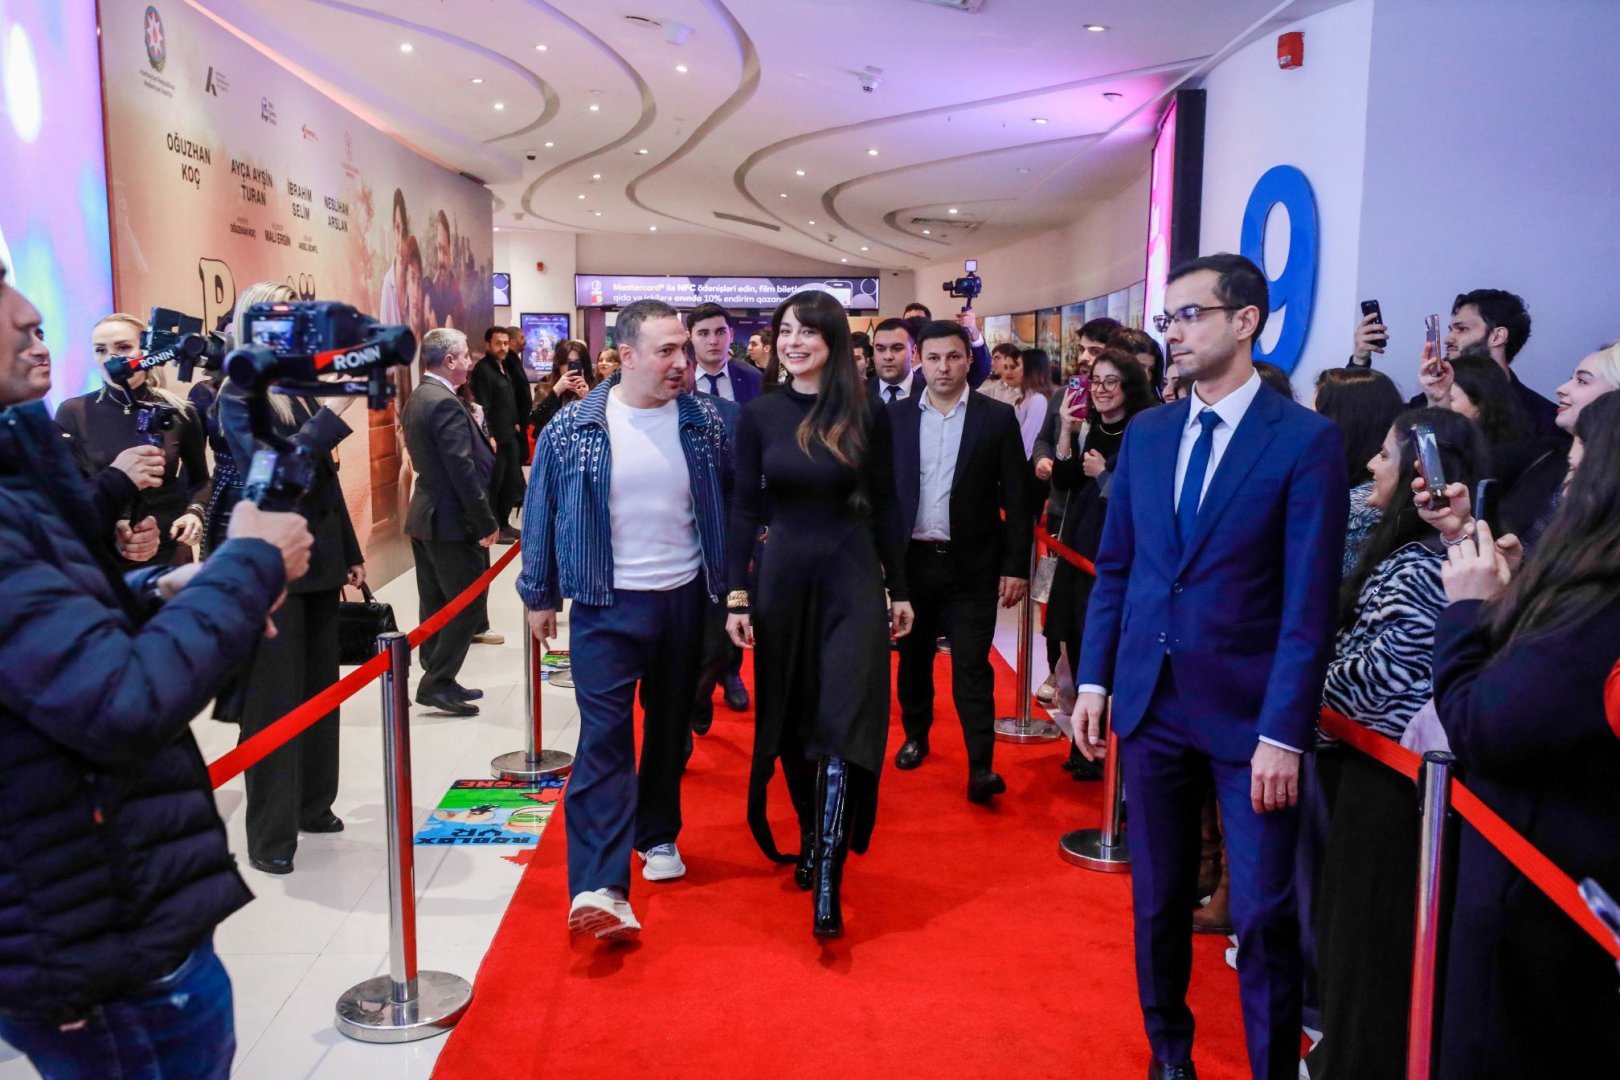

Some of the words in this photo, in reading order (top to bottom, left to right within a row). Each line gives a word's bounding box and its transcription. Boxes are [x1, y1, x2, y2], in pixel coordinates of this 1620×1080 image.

[166, 132, 211, 165] OĞUZHAN
[181, 163, 201, 190] KOÇ
[231, 159, 251, 182] AYÇA
[253, 167, 273, 190] AYŞİN
[241, 184, 266, 206] TURAN
[1240, 164, 1320, 377] 9
[677, 284, 696, 292] NFC
[738, 285, 757, 294] edin,
[759, 284, 775, 293] film
[703, 294, 722, 302] 10%
[724, 293, 755, 303] endirim
[139, 348, 176, 369] RONIN
[333, 345, 381, 371] RONIN
[457, 780, 530, 789] ZONE
[414, 837, 531, 845] ROBLOX
[452, 828, 503, 837] VR
